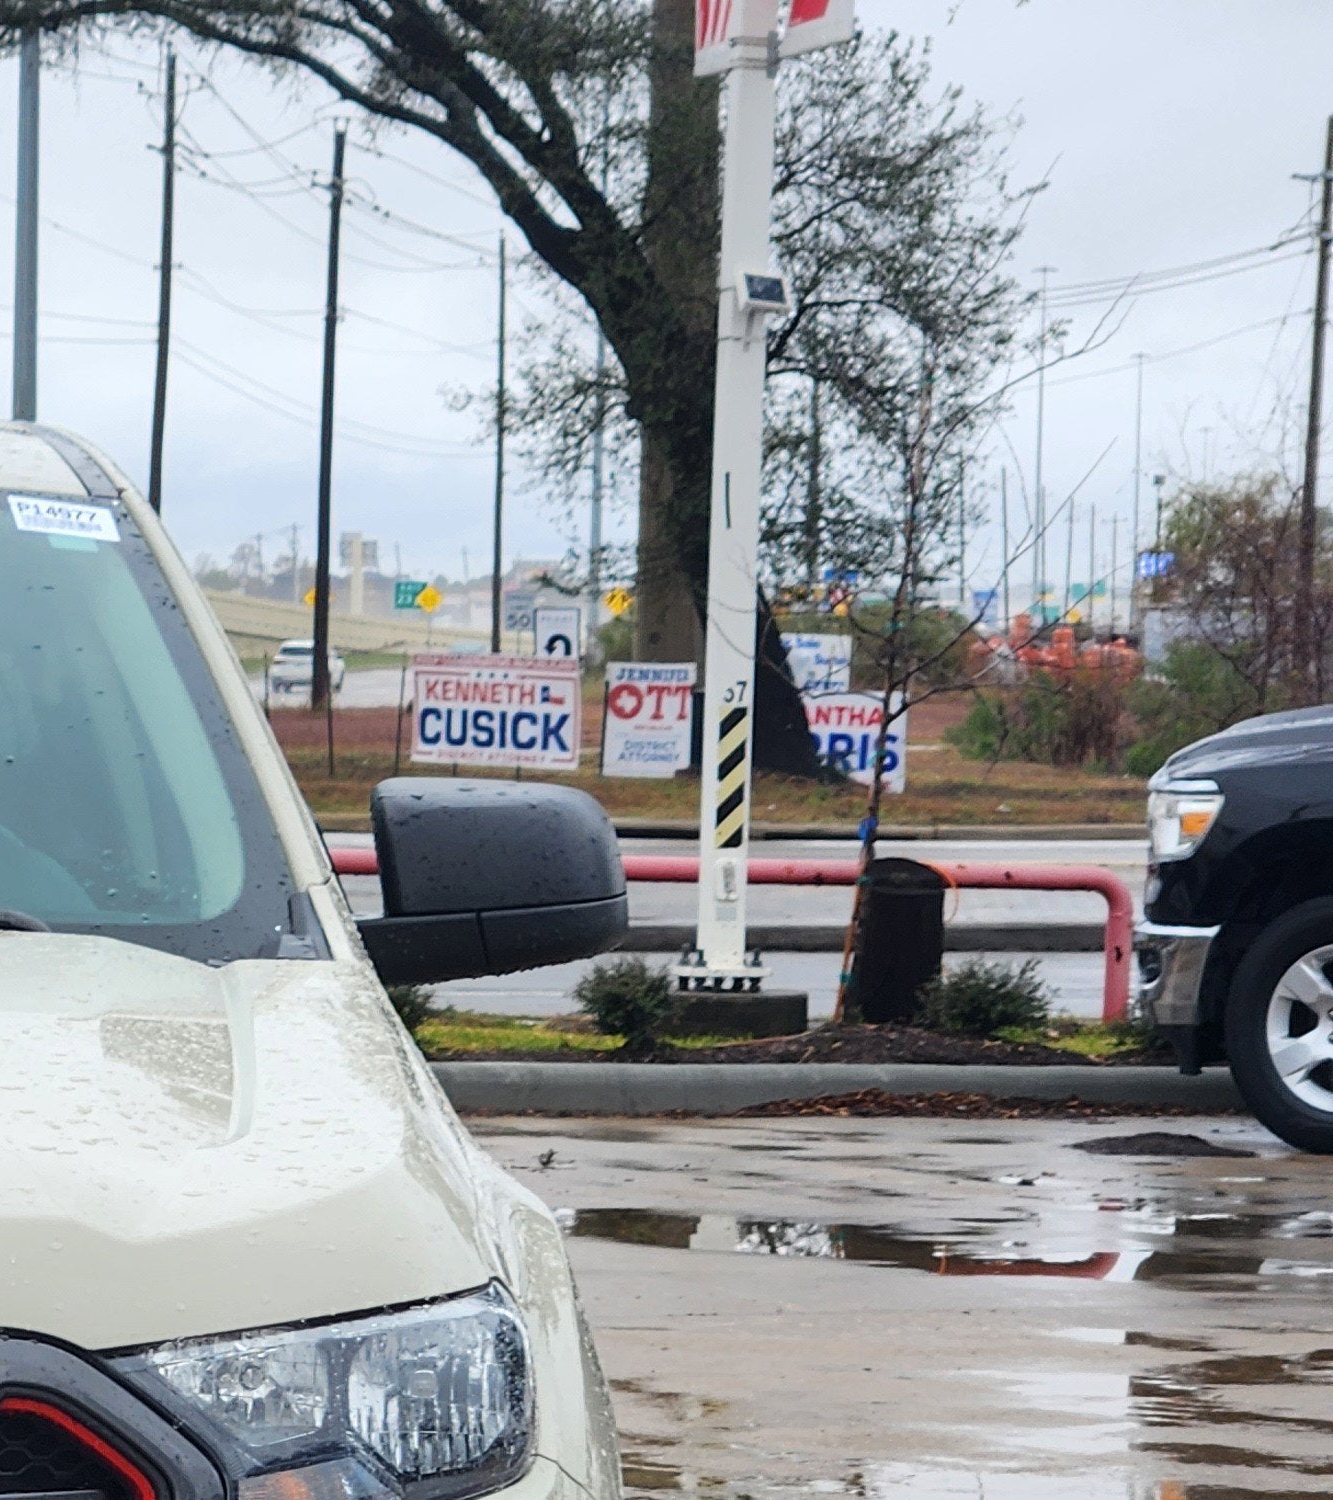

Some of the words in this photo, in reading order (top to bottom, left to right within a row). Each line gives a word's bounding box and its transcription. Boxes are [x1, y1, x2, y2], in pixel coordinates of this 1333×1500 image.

[425, 680, 536, 704] KENNETH
[609, 683, 693, 720] OTT
[420, 707, 571, 751] CUSICK
